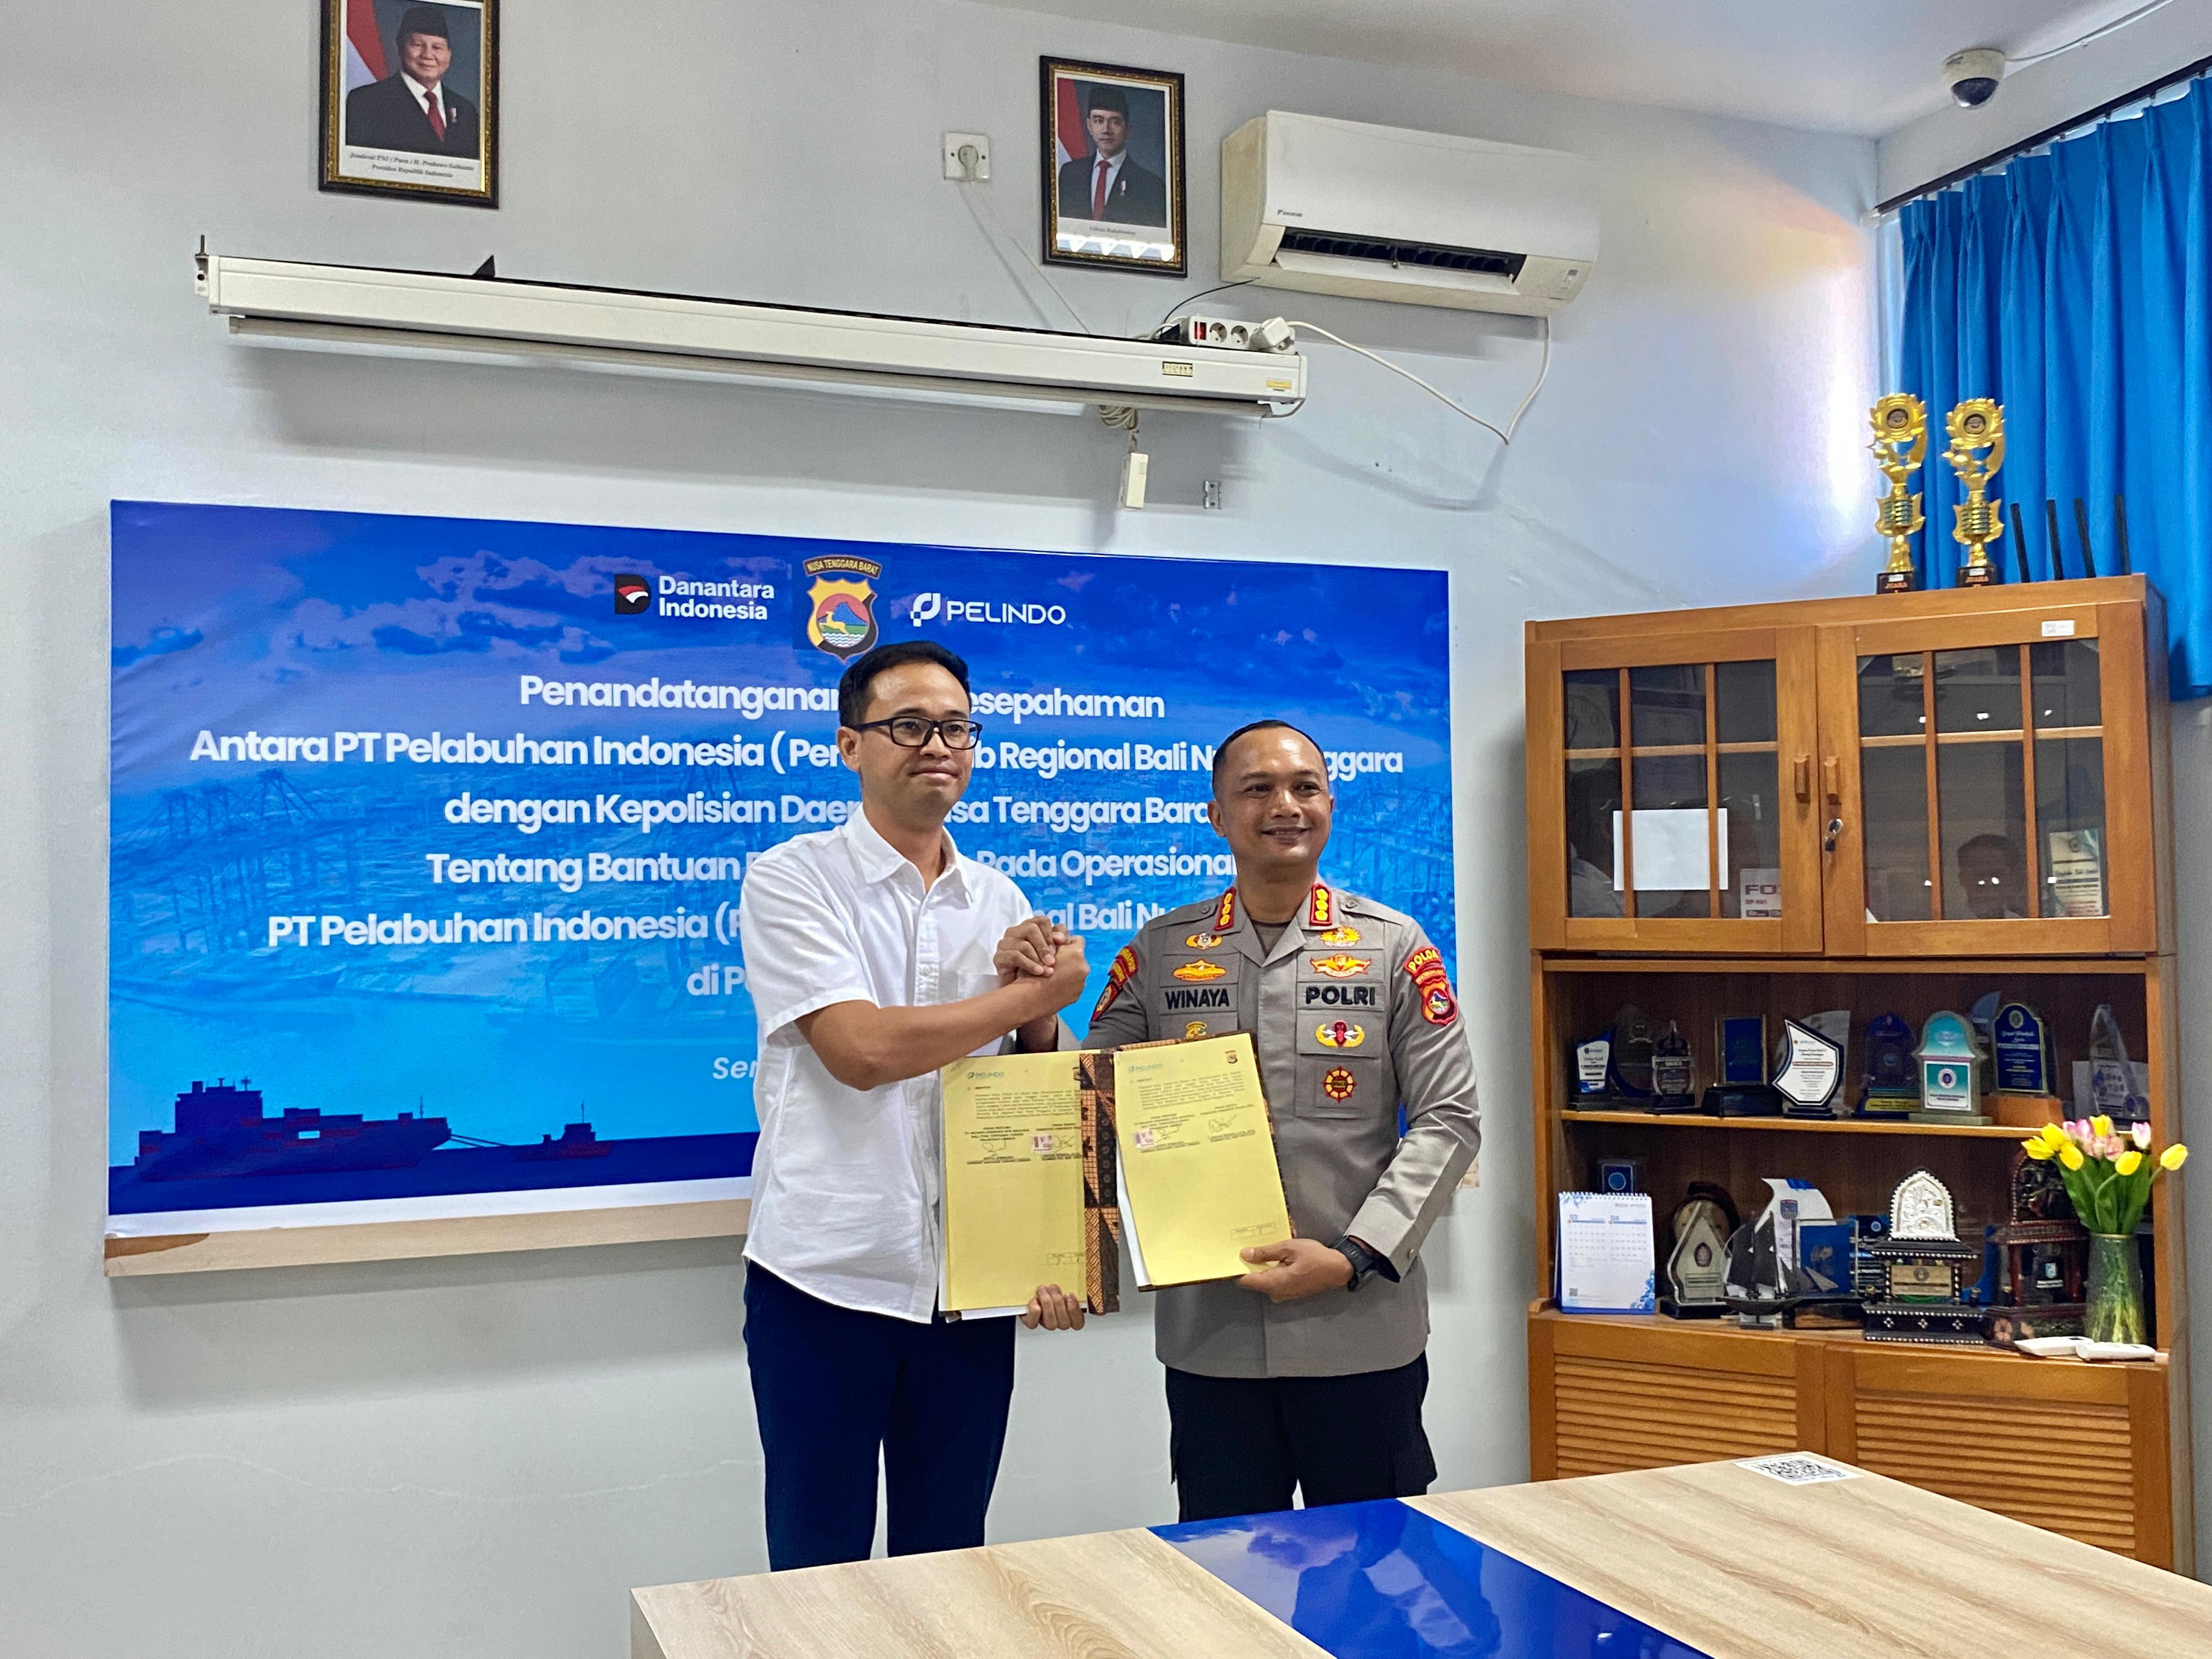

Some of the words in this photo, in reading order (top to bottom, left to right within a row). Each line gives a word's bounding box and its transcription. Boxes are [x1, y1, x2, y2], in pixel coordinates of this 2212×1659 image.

[807, 561, 824, 572] NUSA
[823, 559, 859, 570] TENGGARA
[859, 562, 879, 574] BARAT
[659, 575, 775, 599] Danantara
[659, 597, 768, 620] Indonesia
[947, 601, 1066, 625] PELINDO
[190, 730, 329, 761] Antara
[335, 731, 382, 762] PT
[386, 731, 588, 764] Pelabuhan
[594, 733, 764, 767] Indonesia
[1000, 739, 1130, 779] Regional
[1135, 741, 1187, 771] Bali
[1323, 751, 1403, 782] ggara
[444, 792, 591, 834] dengan
[596, 791, 775, 833] Kepolisian
[993, 796, 1142, 834] Tenggara
[1146, 797, 1212, 824] Bara
[426, 853, 583, 893] Tentang
[588, 852, 741, 882] Bantuan
[268, 915, 316, 947] PT
[320, 912, 528, 945] Pelabuhan
[534, 906, 709, 941] Indonesia
[1079, 900, 1132, 930] Bali
[1408, 949, 1439, 972] POLDA
[1165, 988, 1230, 1009] WINAYA
[1305, 986, 1376, 1006] POLRI
